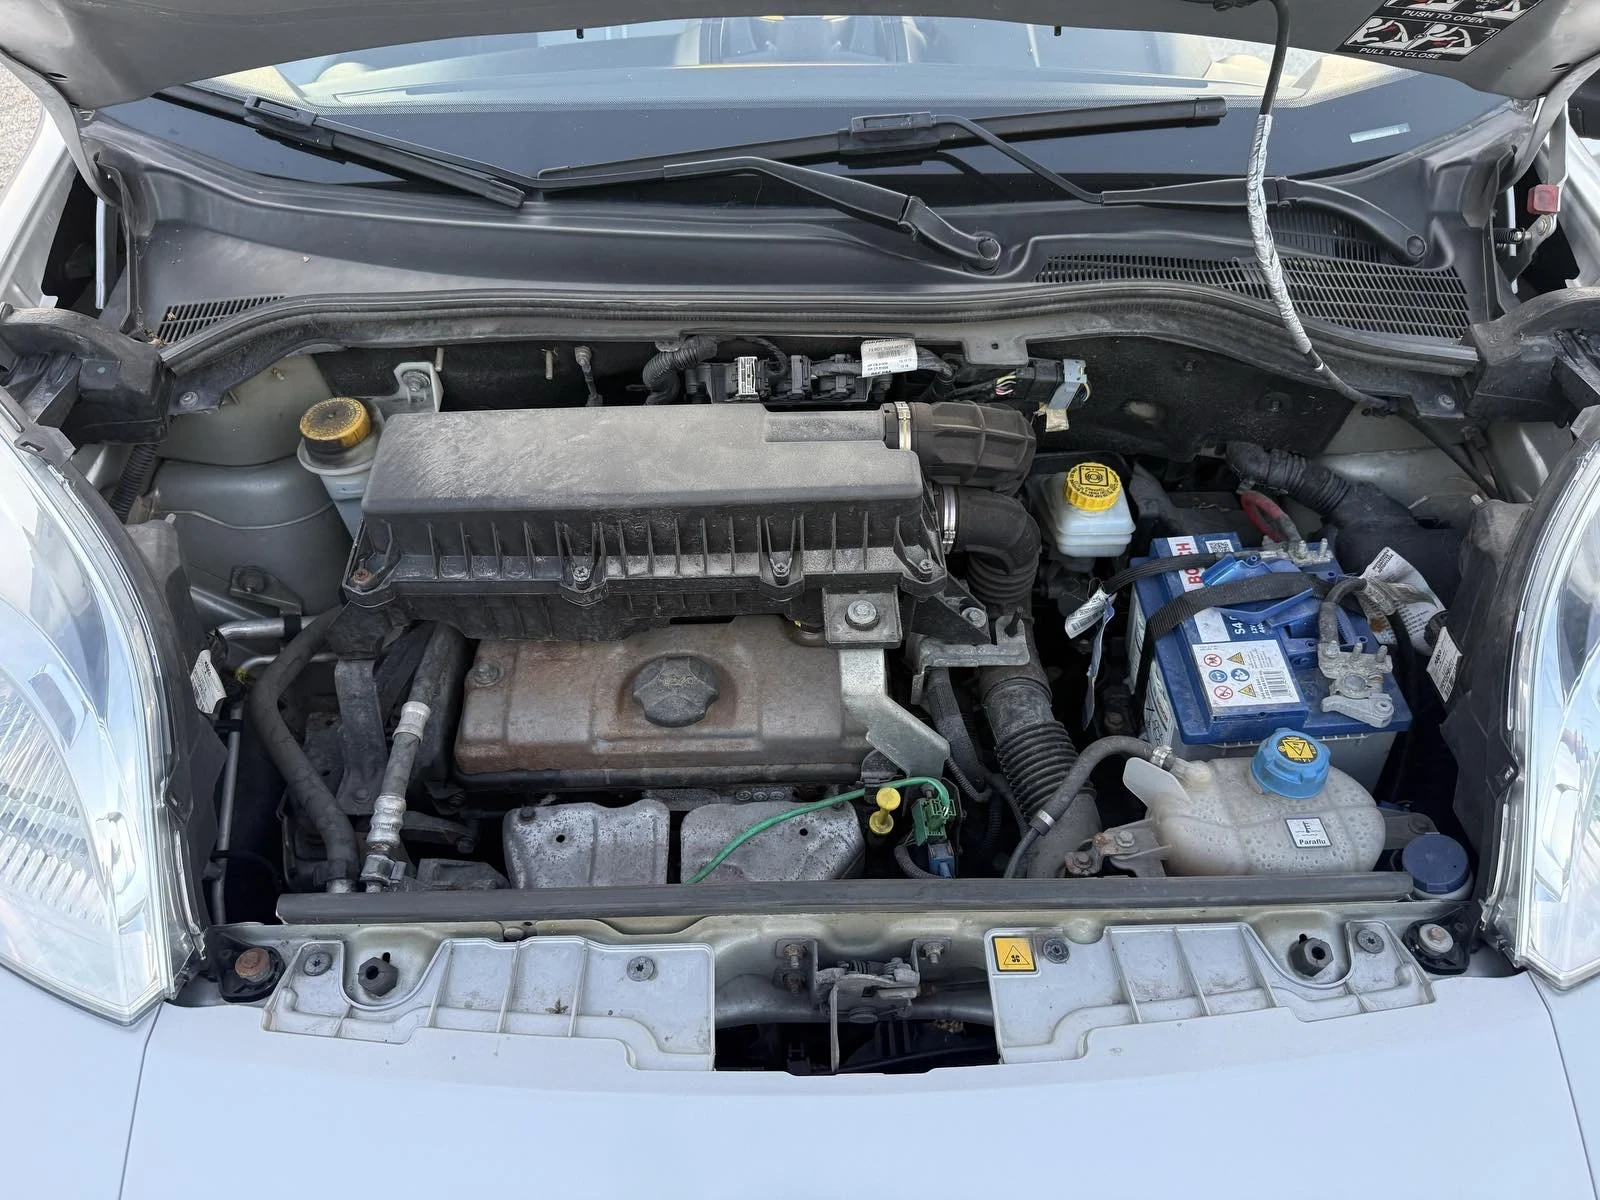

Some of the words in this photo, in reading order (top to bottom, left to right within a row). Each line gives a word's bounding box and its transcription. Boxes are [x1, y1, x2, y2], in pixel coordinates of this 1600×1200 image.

[1401, 9, 1434, 18] PUSH
[1438, 12, 1453, 20] TO
[1453, 14, 1486, 24] OPEN
[1359, 47, 1386, 55] PULL
[1404, 51, 1443, 60] CLOSE
[1231, 622, 1246, 635] S4
